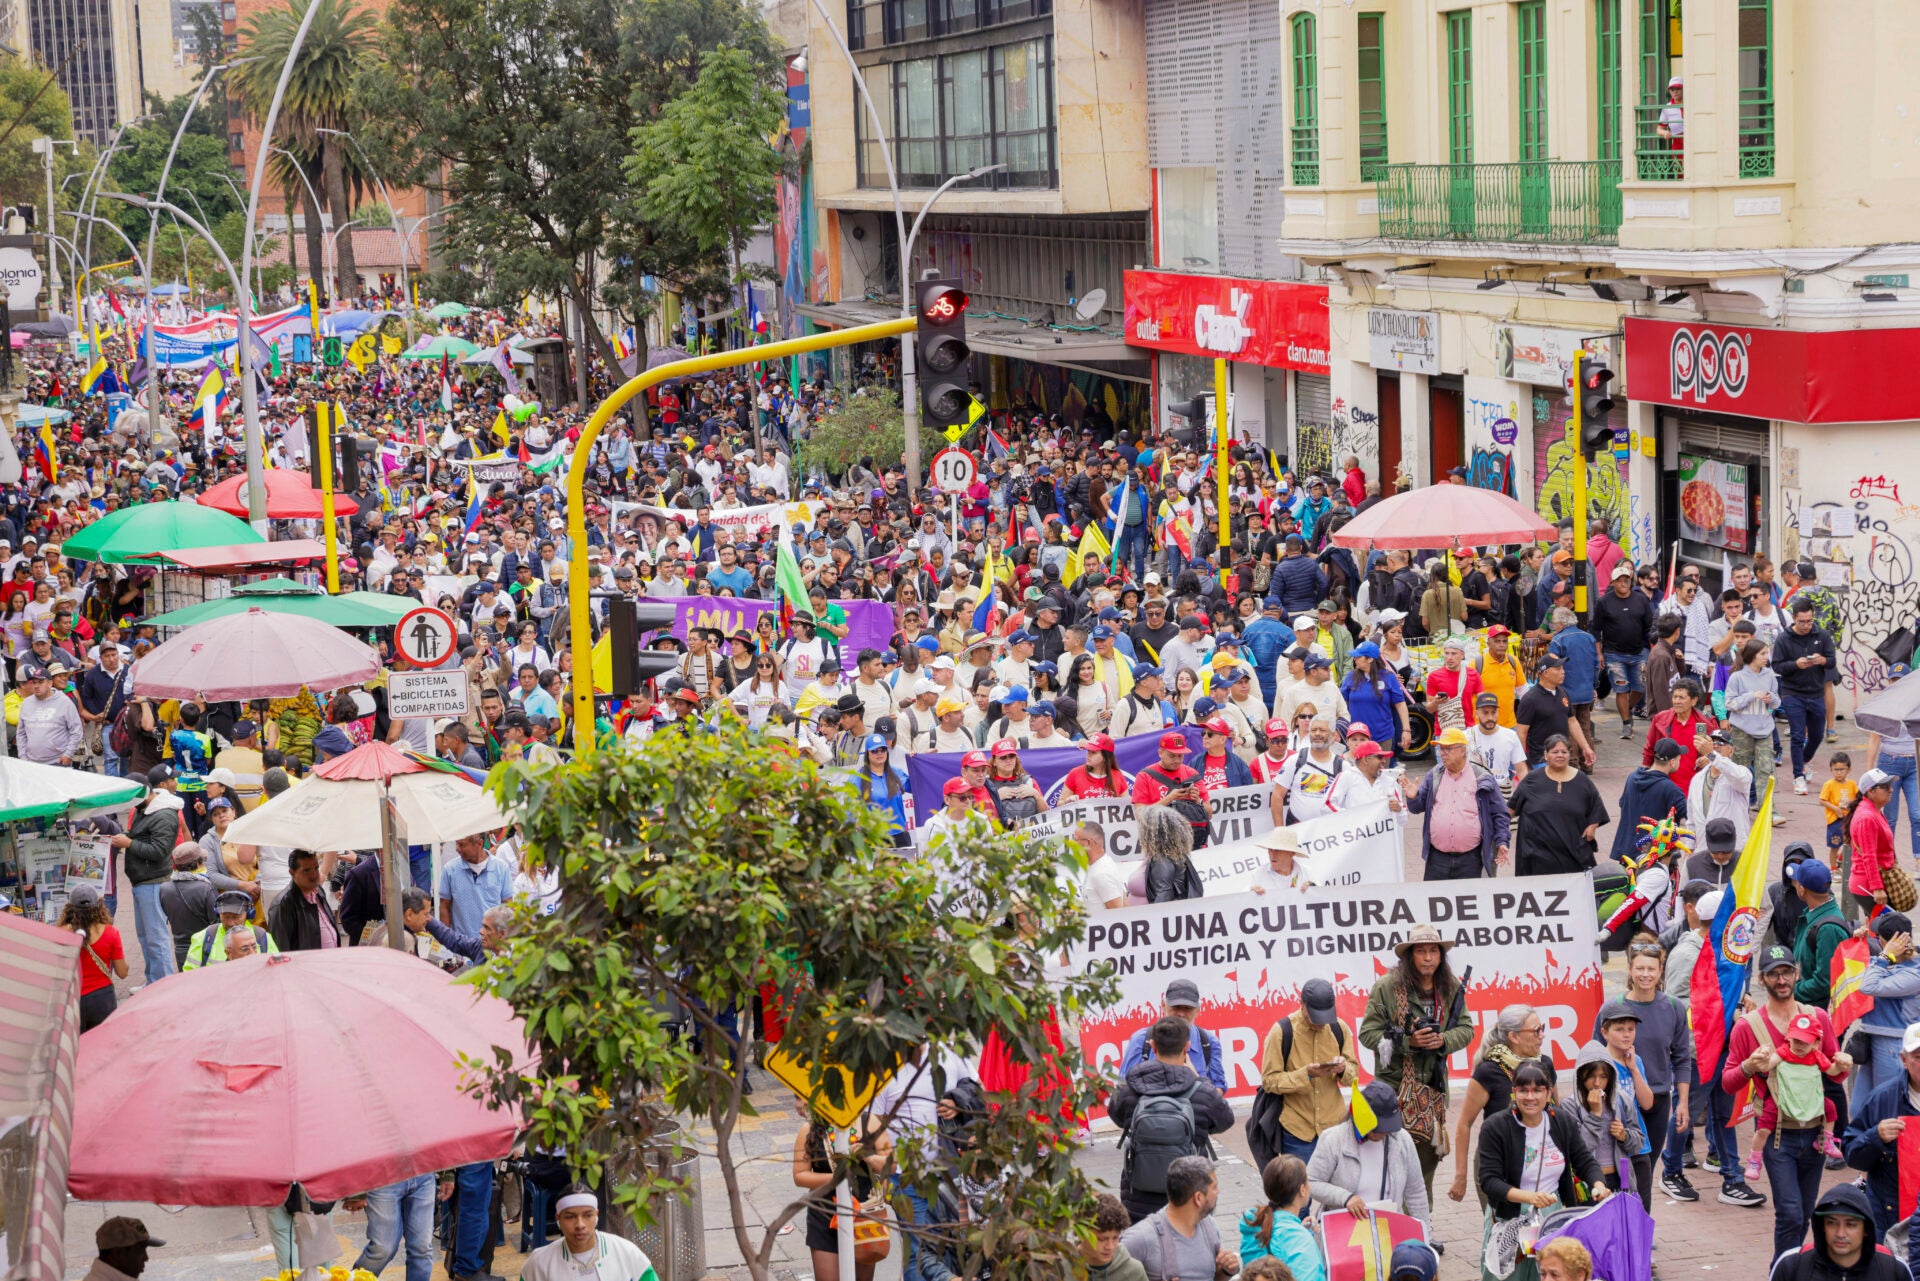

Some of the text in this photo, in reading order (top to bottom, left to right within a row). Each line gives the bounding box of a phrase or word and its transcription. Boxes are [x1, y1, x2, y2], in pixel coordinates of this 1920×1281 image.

[1891, 276, 1903, 286] 22
[1136, 317, 1160, 342] outlet
[1194, 297, 1248, 353] Claro
[1367, 311, 1382, 336] LOS
[1670, 327, 1749, 403] ppc
[1495, 421, 1514, 431] WOM
[450, 462, 519, 481] Paestina
[942, 459, 967, 482] 10
[1725, 463, 1745, 485] PIZZA
[405, 676, 448, 687] SISTEMA
[400, 689, 457, 700] BICICLETAS
[394, 702, 465, 714] COMPARTIDAS
[181, 749, 194, 772] 1
[1061, 806, 1088, 828] DE
[1342, 818, 1394, 844] SALUD
[79, 842, 95, 850] VOZ
[1088, 890, 1570, 952] POR UNA CULTURA DE PAZ
[1143, 942, 1252, 972] JUSTICIA
[1258, 939, 1277, 959] Y
